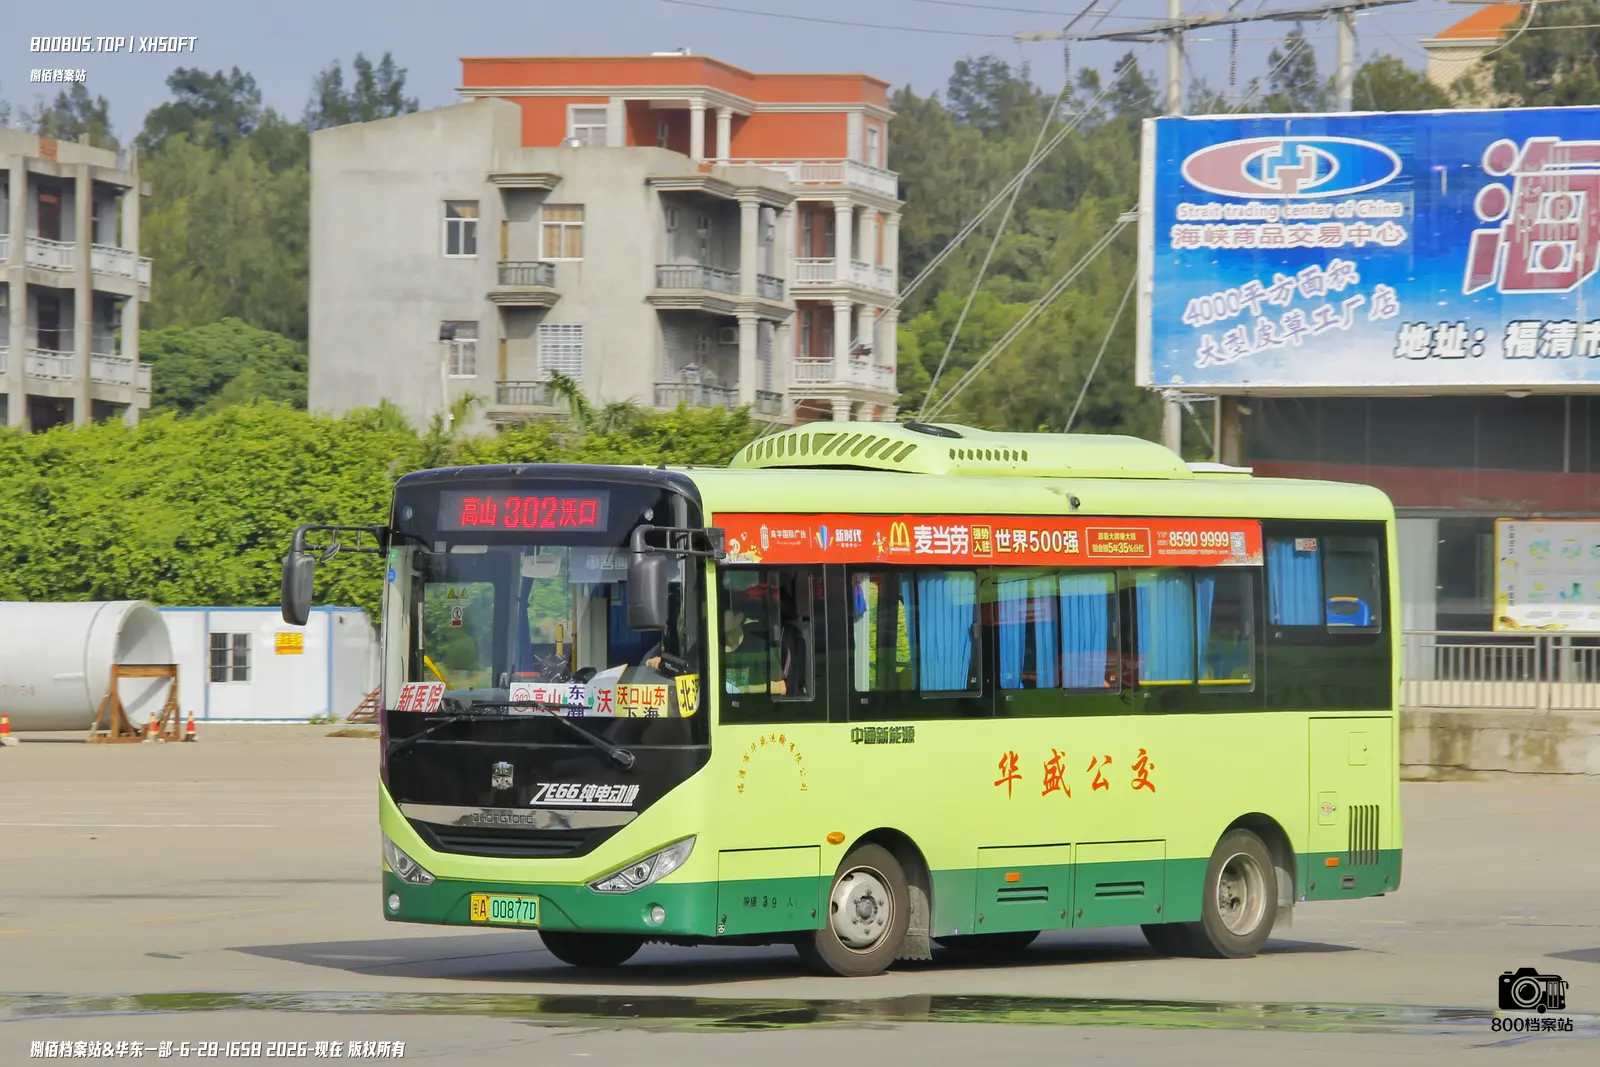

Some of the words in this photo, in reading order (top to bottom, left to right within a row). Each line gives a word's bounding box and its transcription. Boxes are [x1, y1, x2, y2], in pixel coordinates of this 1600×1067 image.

[1178, 203, 1222, 219] Strait
[1225, 203, 1279, 222] trading
[1284, 203, 1334, 219] center
[1337, 202, 1356, 217] of
[1358, 201, 1403, 217] China
[1172, 223, 1407, 248] 海峡商品交易中心
[1182, 258, 1360, 327] 4000平方面积
[1195, 284, 1400, 368] 大型皮草工厂店
[461, 497, 497, 526] 高山
[504, 496, 558, 529] 302
[560, 499, 597, 527] 沃口
[835, 528, 862, 543] 新时代
[913, 524, 969, 555] 麦当劳
[972, 528, 990, 540] 强势
[994, 530, 1079, 555] 世界500强
[1169, 531, 1198, 547] 8590
[1200, 531, 1229, 547] 9999
[973, 541, 991, 553] 入驻
[395, 684, 443, 712] 新医院
[597, 689, 613, 713] 沃
[851, 726, 915, 745] 中通新能源
[993, 748, 1156, 799] 华盛公交
